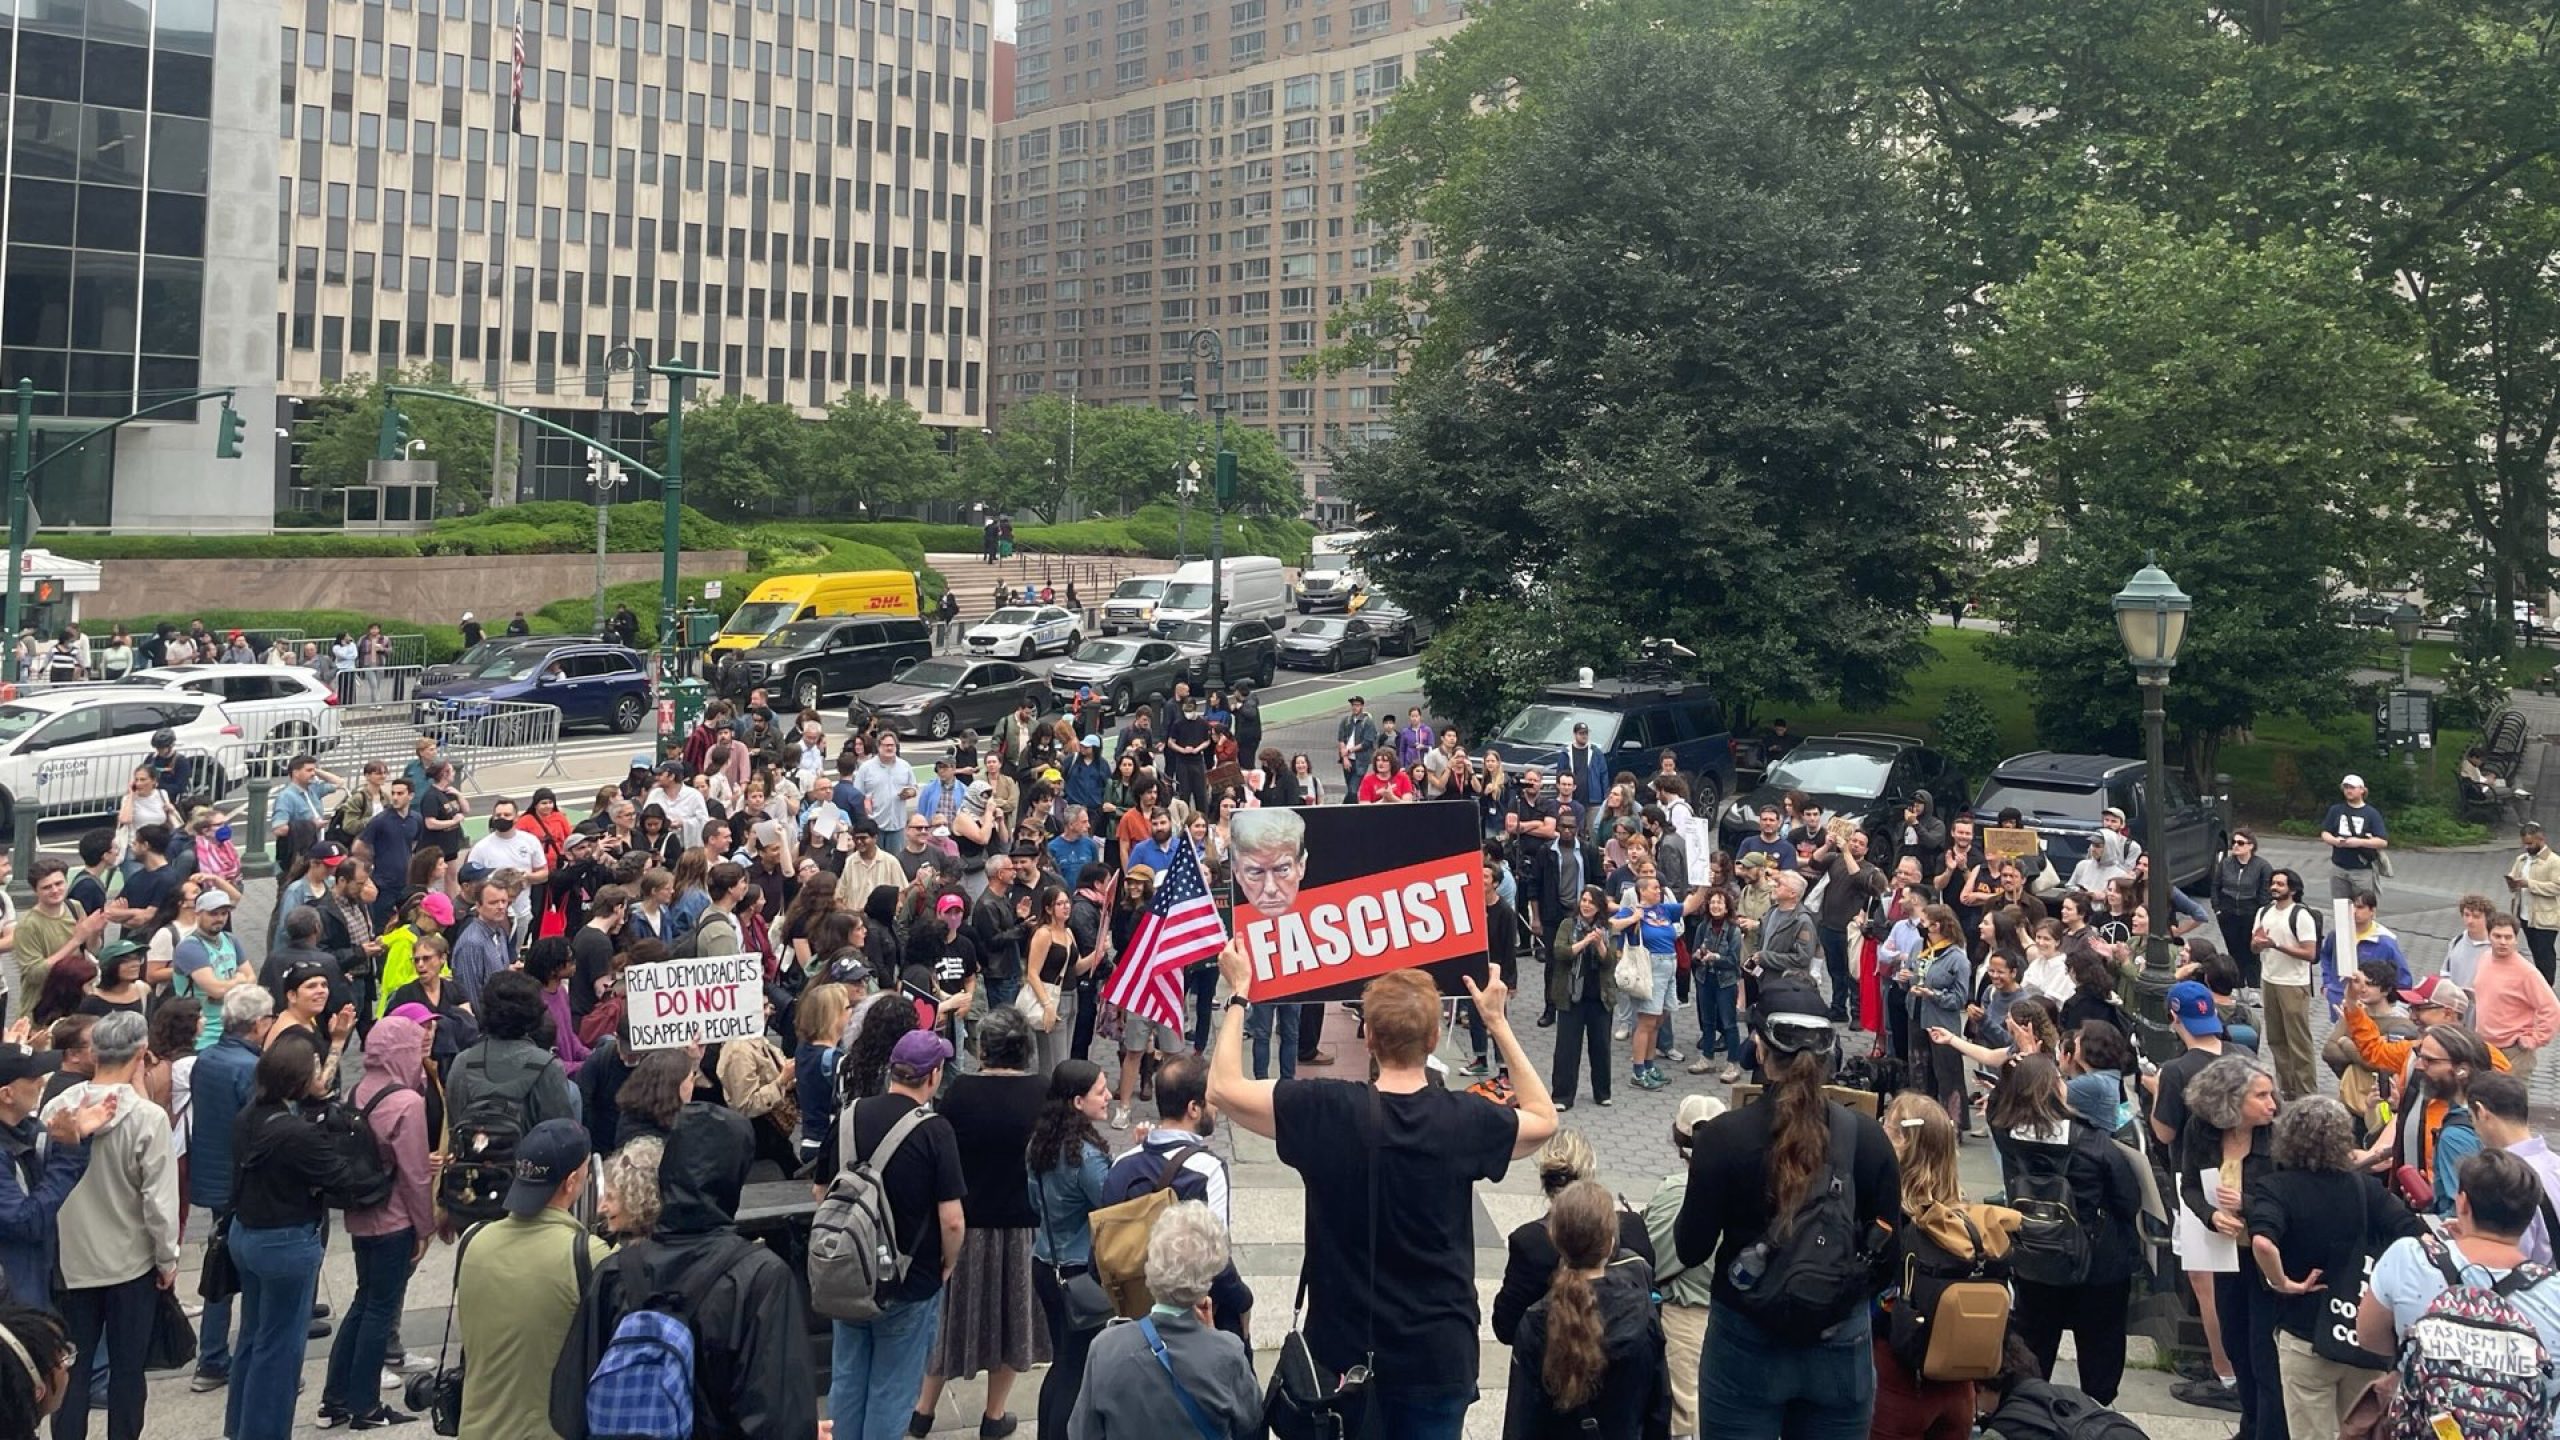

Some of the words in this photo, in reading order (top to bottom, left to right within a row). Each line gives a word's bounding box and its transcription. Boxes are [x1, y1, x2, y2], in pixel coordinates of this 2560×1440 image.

[870, 596, 902, 608] DHL
[1246, 873, 1473, 982] FASCIST
[627, 968, 665, 992] REAL
[667, 959, 758, 989] DEMOCRACIES
[655, 989, 689, 1018] DO
[695, 984, 740, 1014] NOT
[631, 1020, 700, 1046] DISAPPEAR
[705, 1015, 754, 1039] PEOPLE
[2423, 1324, 2497, 1350] FASCISM
[2506, 1336, 2521, 1354] IS
